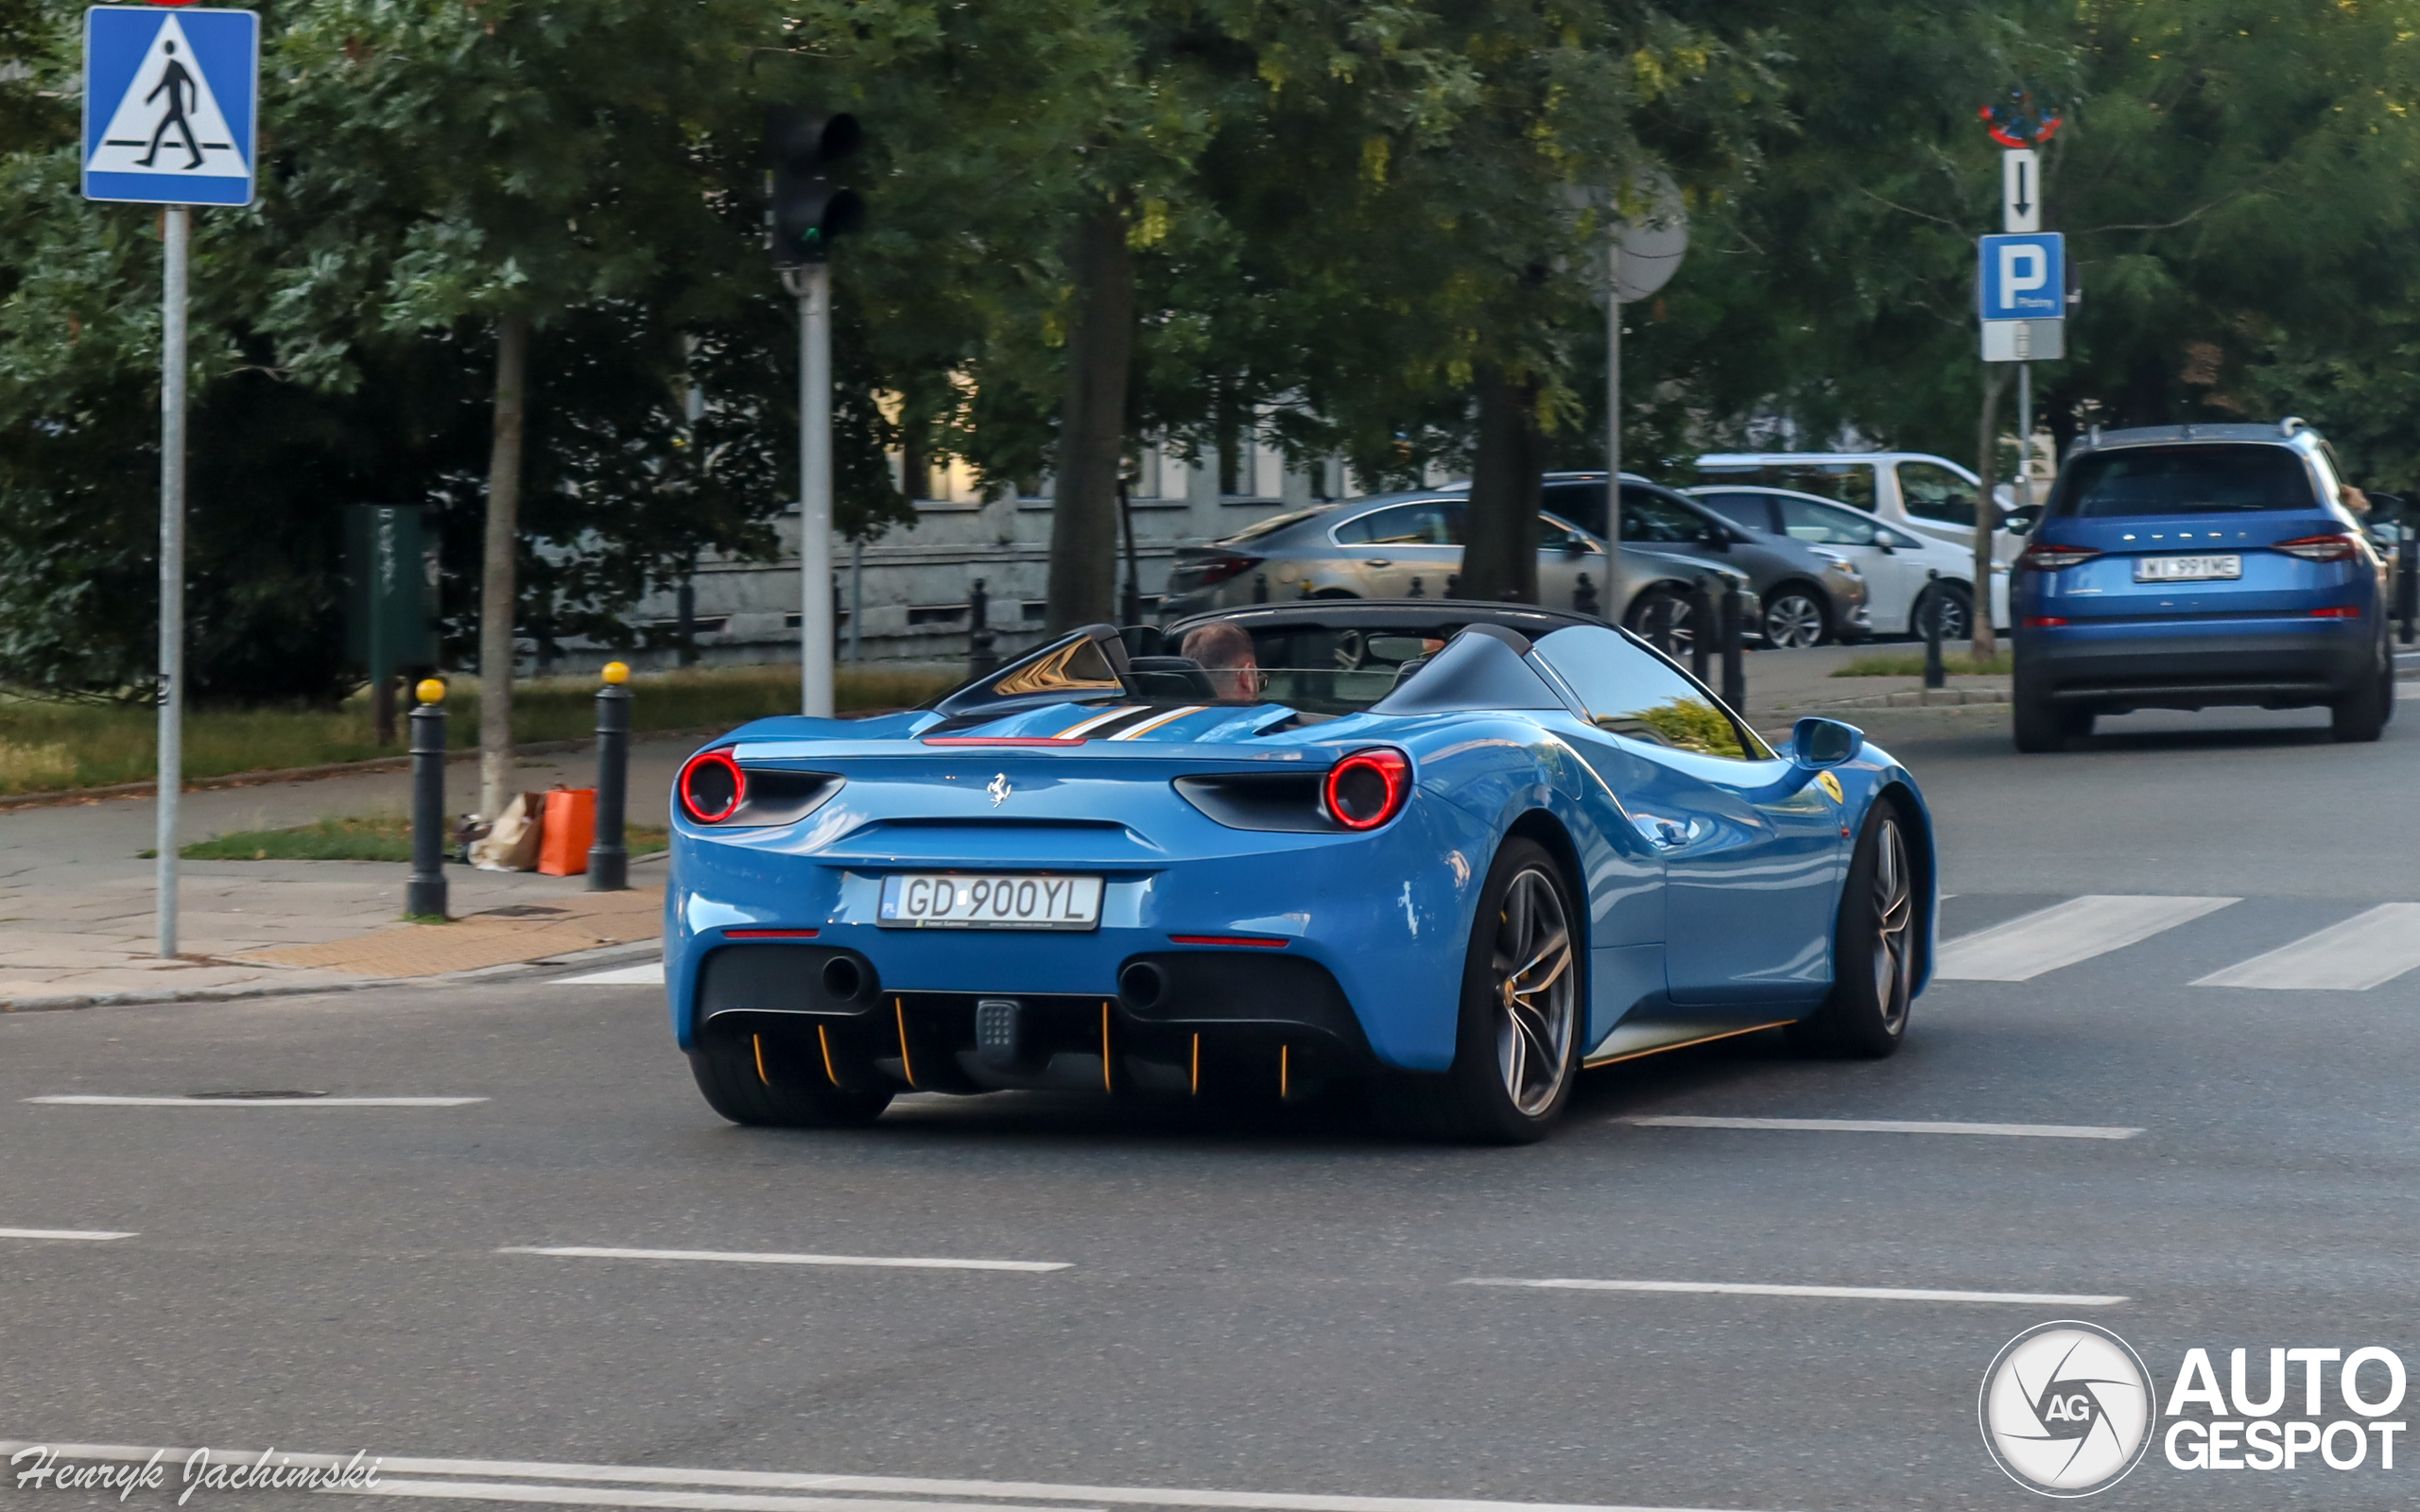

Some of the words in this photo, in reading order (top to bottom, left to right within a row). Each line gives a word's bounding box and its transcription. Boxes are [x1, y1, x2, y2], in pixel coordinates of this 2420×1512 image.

[1998, 244, 2048, 309] P
[883, 902, 896, 914] PL
[908, 879, 955, 917] GD
[968, 880, 1084, 919] 900YL
